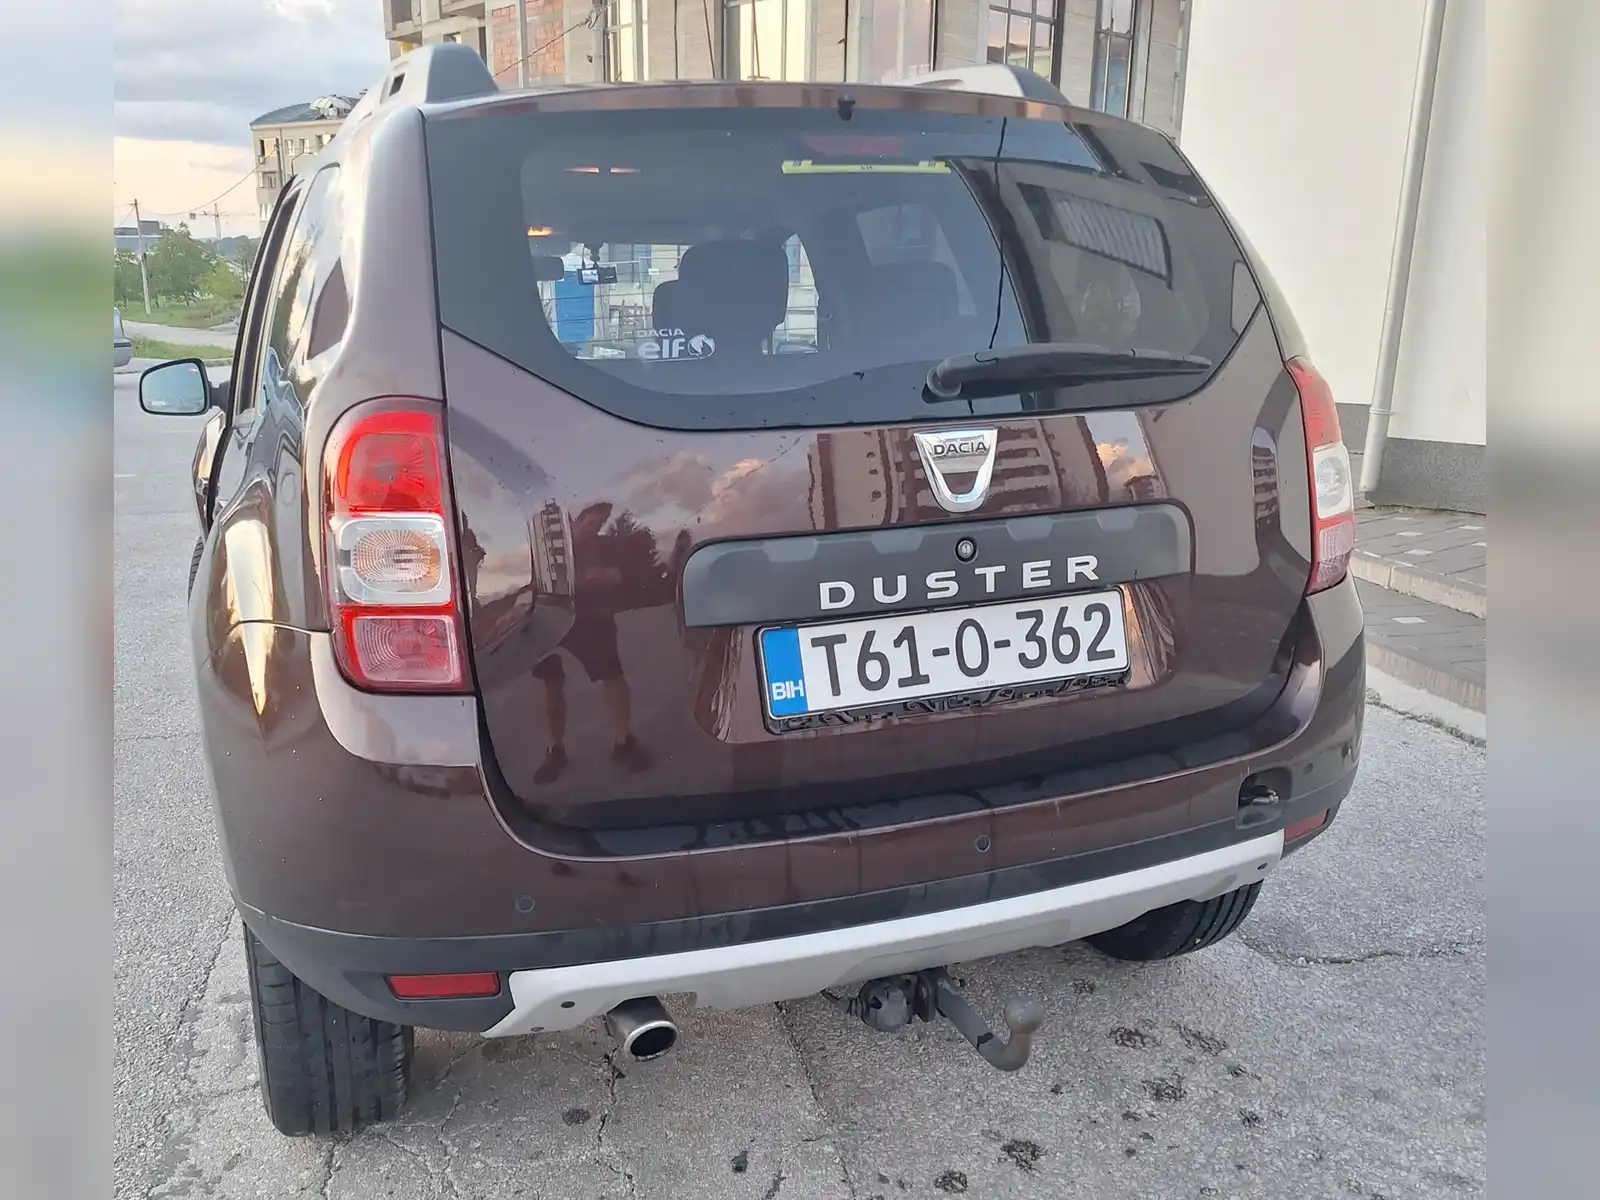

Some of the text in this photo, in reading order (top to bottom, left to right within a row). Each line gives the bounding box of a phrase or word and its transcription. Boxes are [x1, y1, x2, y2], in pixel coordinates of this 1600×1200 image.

[636, 328, 684, 338] DACIA
[638, 338, 686, 359] elf
[933, 441, 987, 455] DACIA
[819, 554, 1099, 610] DUSTER
[771, 679, 805, 701] BIH
